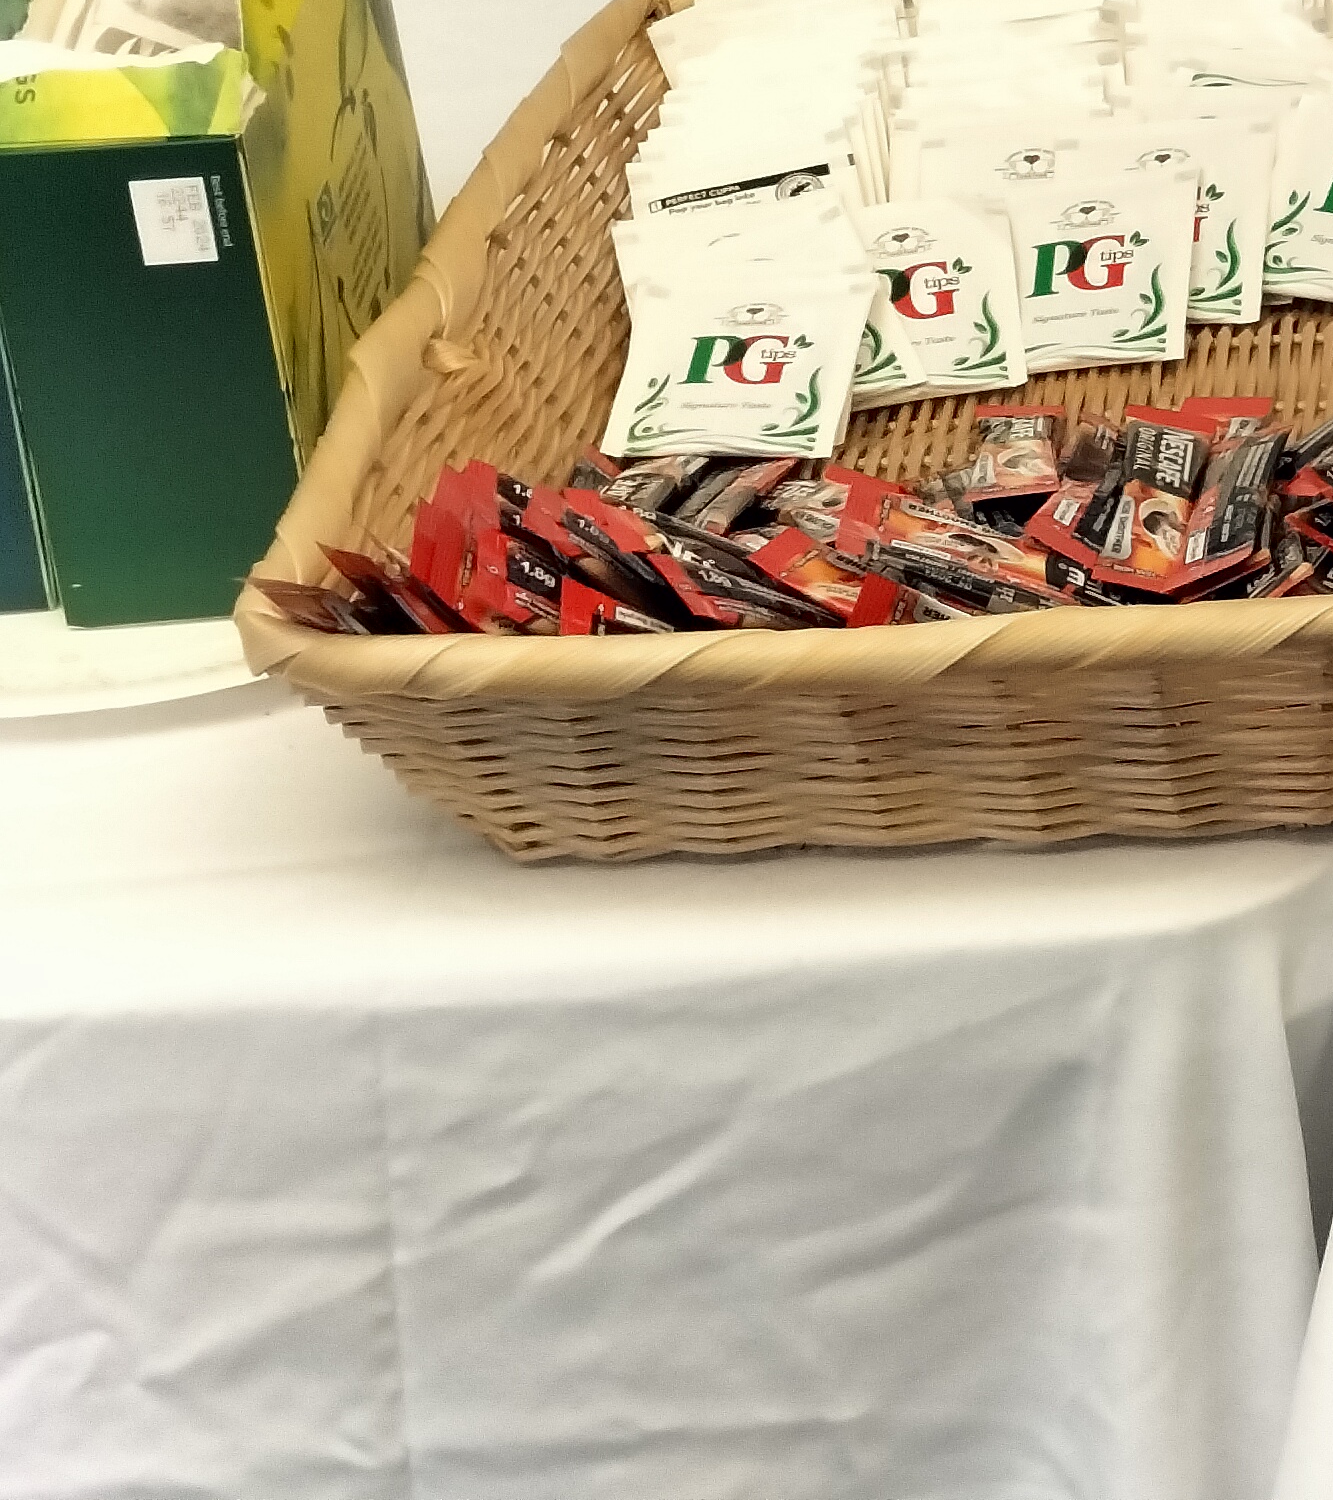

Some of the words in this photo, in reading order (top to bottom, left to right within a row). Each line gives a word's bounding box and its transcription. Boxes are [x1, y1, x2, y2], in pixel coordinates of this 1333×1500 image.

[924, 275, 960, 290] tips
[1024, 234, 1134, 299] PG
[1099, 249, 1135, 264] tips
[676, 334, 792, 385] PG
[760, 347, 797, 362] tips
[1133, 426, 1157, 471] ORIGINAL
